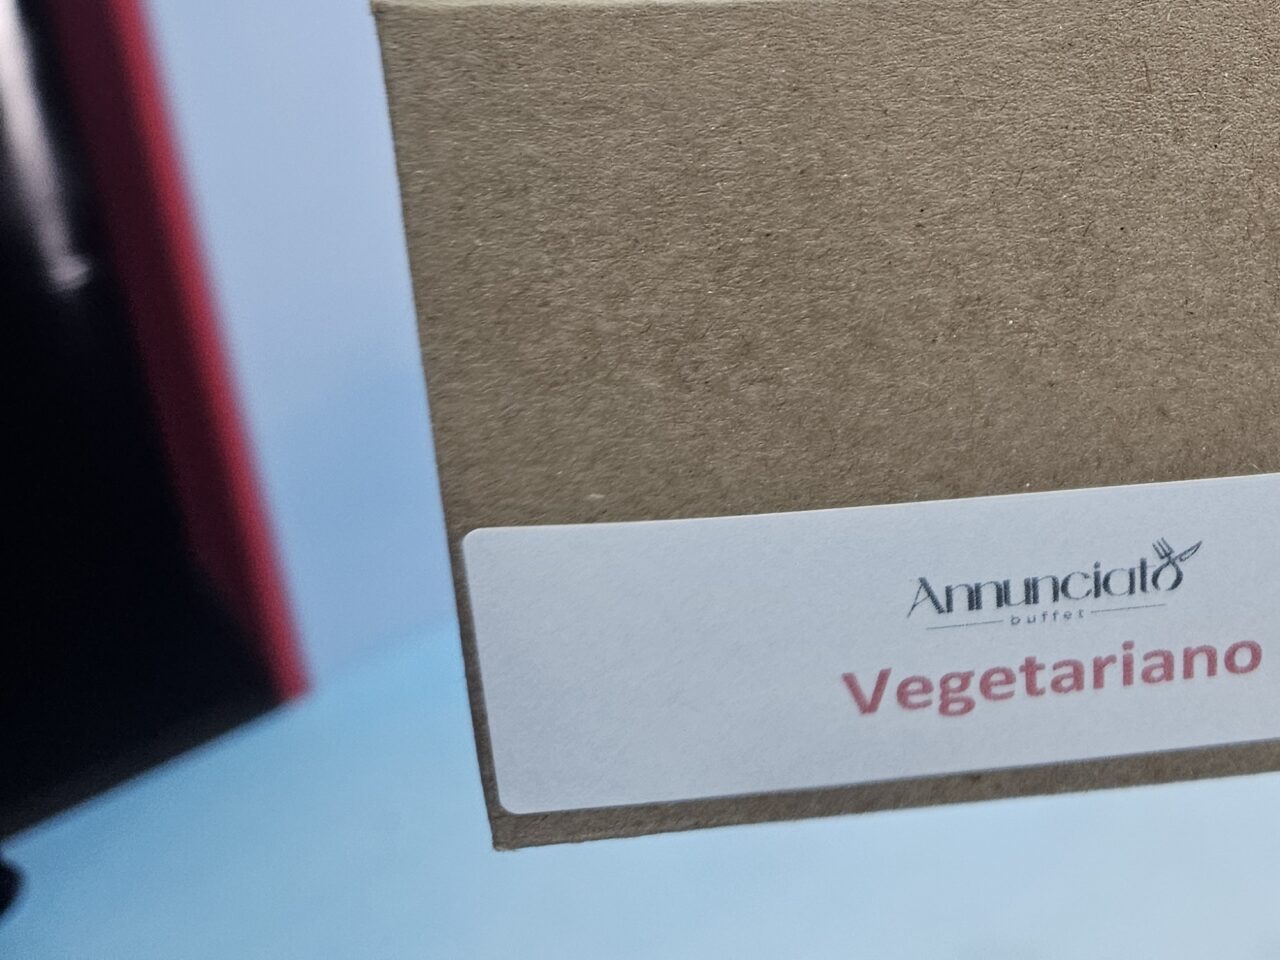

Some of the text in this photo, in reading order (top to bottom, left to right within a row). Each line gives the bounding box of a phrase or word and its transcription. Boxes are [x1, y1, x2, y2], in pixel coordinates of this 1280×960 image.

[907, 538, 1202, 618] Annunciato
[1010, 609, 1086, 627] buffet
[841, 640, 1263, 717] Vegetariano
